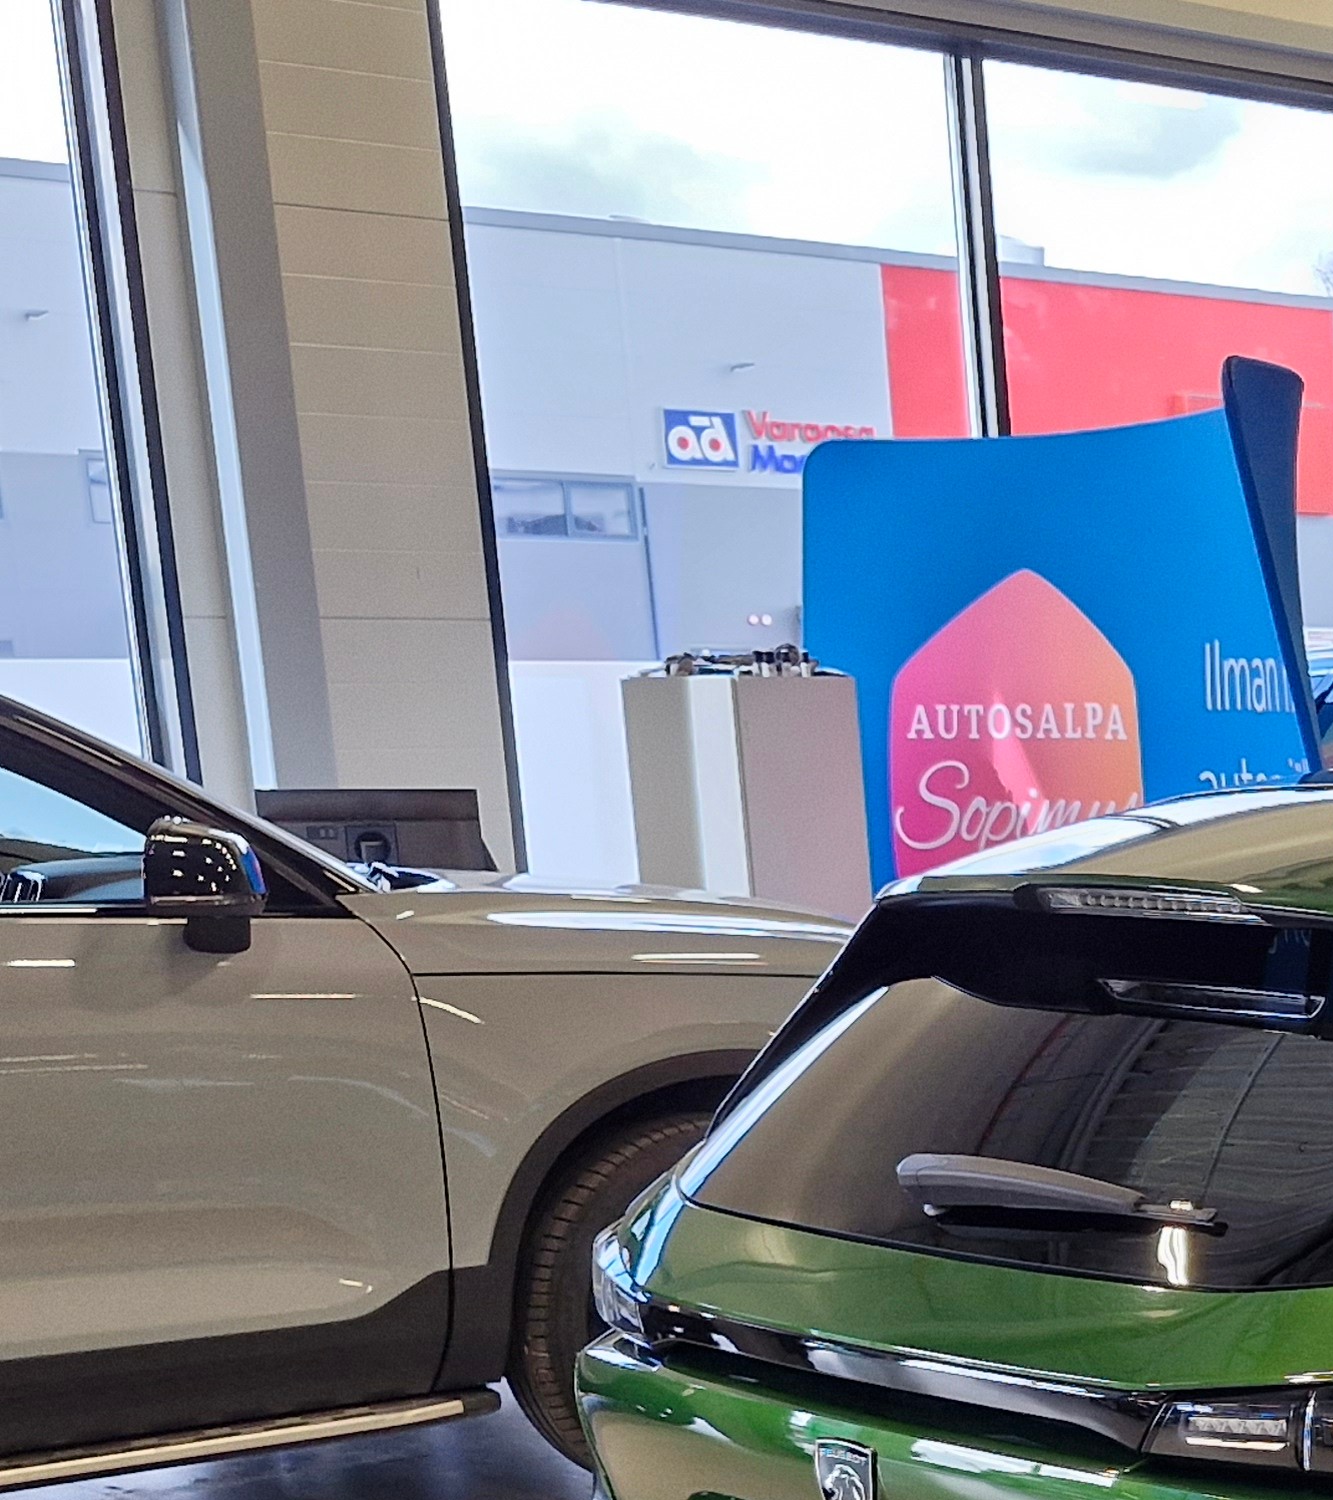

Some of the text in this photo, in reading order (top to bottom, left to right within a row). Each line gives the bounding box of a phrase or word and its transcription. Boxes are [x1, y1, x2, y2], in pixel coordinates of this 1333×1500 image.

[1204, 638, 1281, 714] Ilman
[906, 703, 1128, 741] AUTOSALPA
[894, 760, 1139, 852] Sopim
